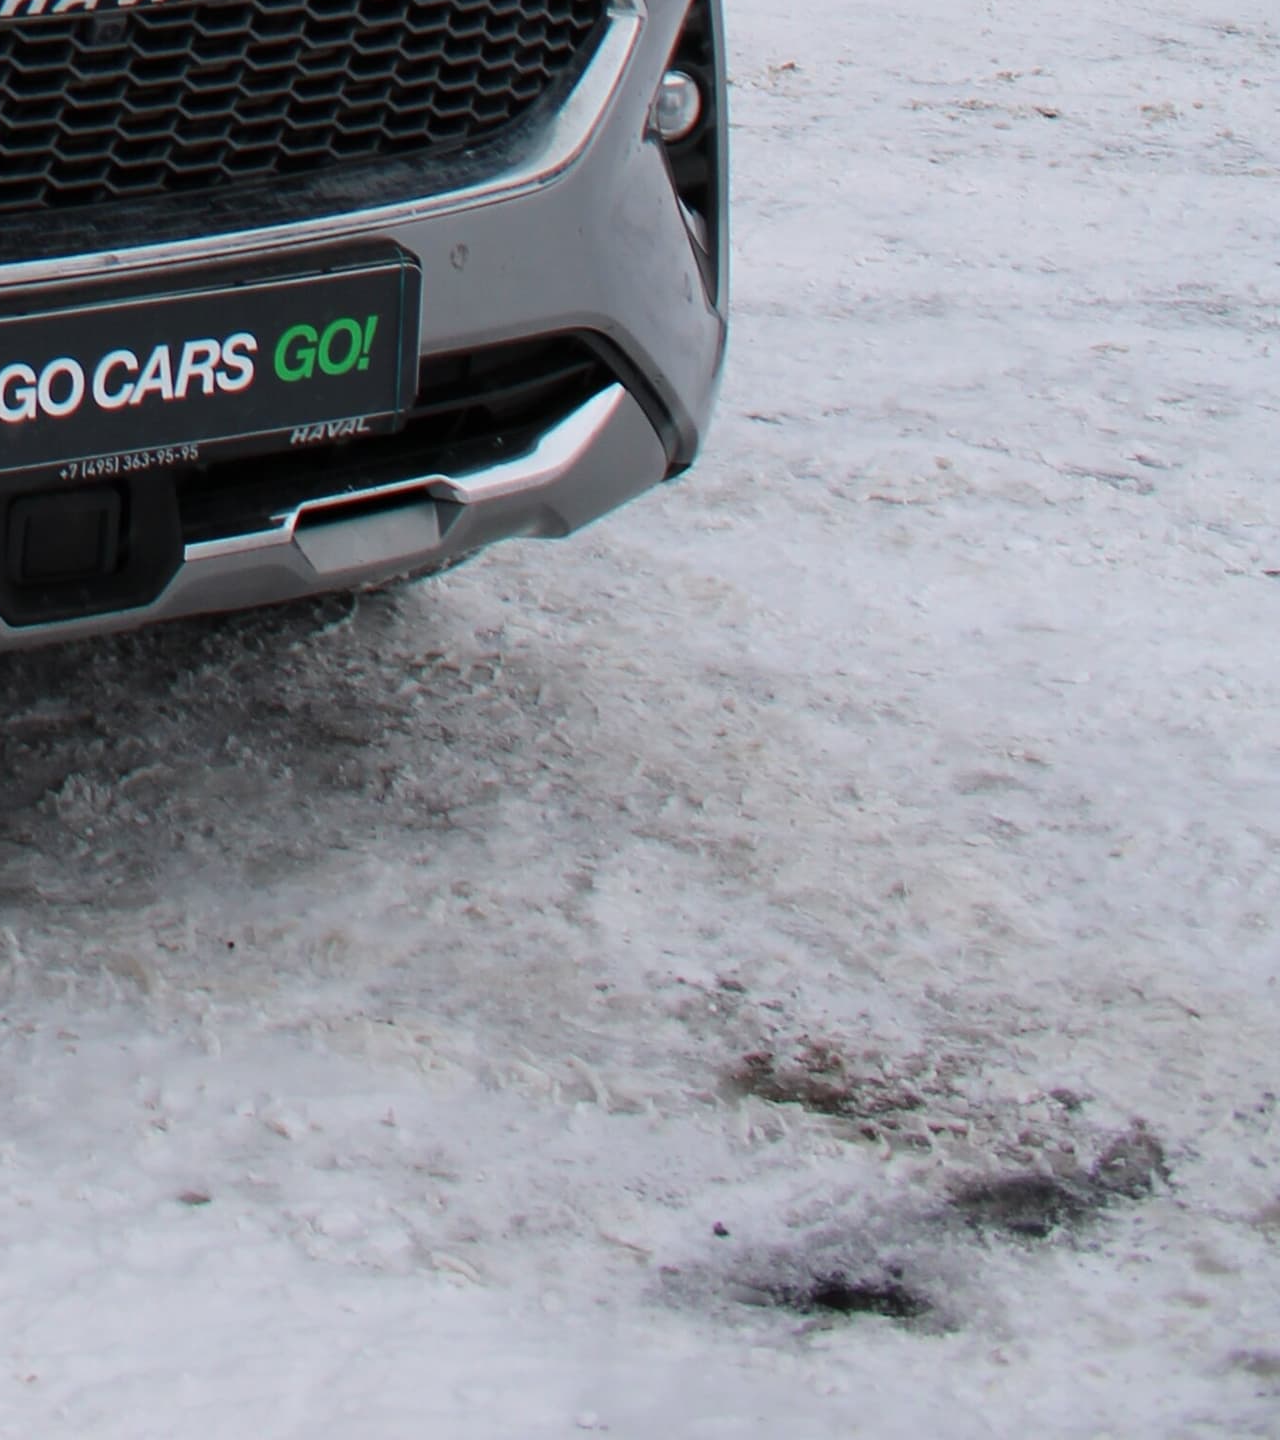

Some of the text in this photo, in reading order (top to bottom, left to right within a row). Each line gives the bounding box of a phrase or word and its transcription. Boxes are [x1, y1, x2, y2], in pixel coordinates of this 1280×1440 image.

[93, 333, 258, 409] CARS
[274, 315, 378, 382] GO!
[290, 416, 371, 445] HAVAL
[59, 443, 200, 480] +7 (495) 363-95-95
